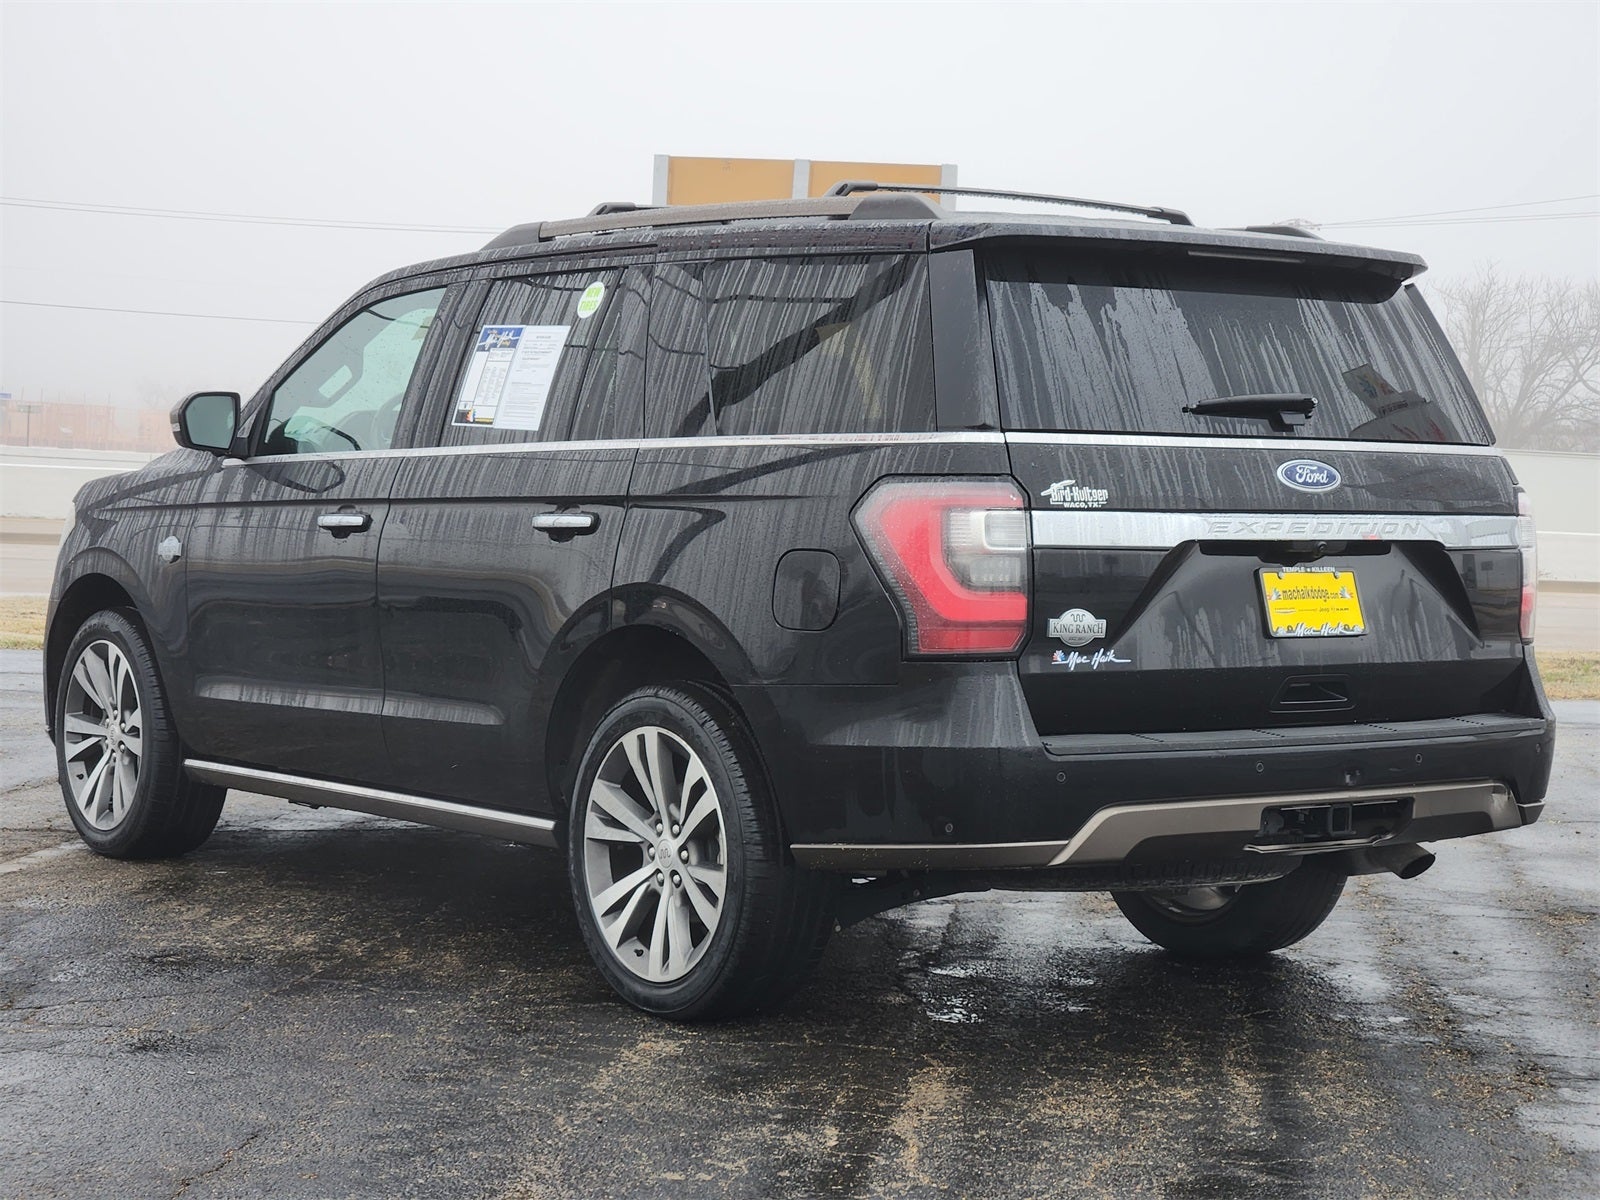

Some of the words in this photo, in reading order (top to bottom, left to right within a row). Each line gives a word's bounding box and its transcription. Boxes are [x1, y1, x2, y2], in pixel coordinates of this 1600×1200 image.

[1296, 464, 1329, 484] Ford
[1050, 484, 1109, 502] Bird-Kultgen
[1063, 501, 1087, 509] WACO,
[1208, 519, 1422, 537] EXPEDITION
[1053, 622, 1074, 635] KING
[1075, 623, 1104, 635] RANCH
[1091, 647, 1131, 670] Haik
